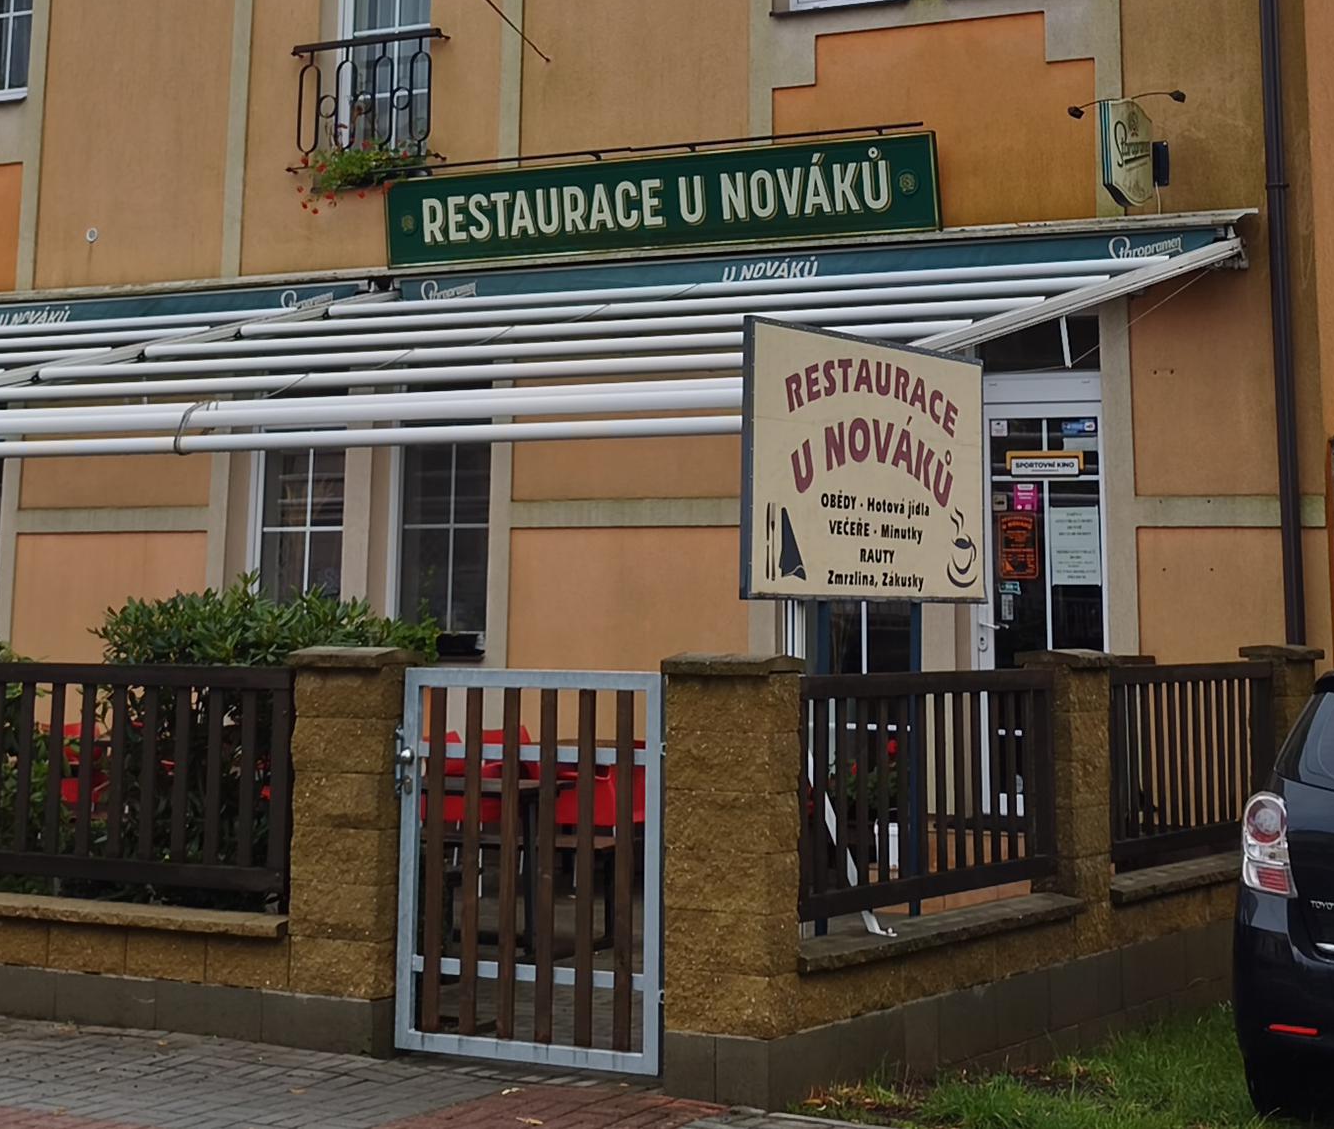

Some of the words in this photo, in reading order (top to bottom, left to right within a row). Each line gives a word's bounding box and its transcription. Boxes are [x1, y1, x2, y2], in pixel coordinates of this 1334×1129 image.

[422, 178, 666, 244] RESTAURACE
[678, 175, 706, 225] U
[720, 146, 891, 221] NOVÁKŮ
[721, 266, 736, 282] U
[739, 255, 818, 281] NOVÁKŮ
[785, 358, 958, 438] RESTAURACE
[791, 438, 814, 493] U
[824, 416, 953, 508] NOVÁKŮ
[821, 490, 857, 510] OBĚDY
[867, 497, 905, 514] Hotová
[908, 500, 930, 519] jídla
[829, 516, 870, 537] VEČEŘE
[881, 524, 923, 545] Minutky
[859, 548, 895, 563] RAUTY
[827, 570, 878, 588] Zmrzlina,
[882, 571, 924, 592] Zákusky
